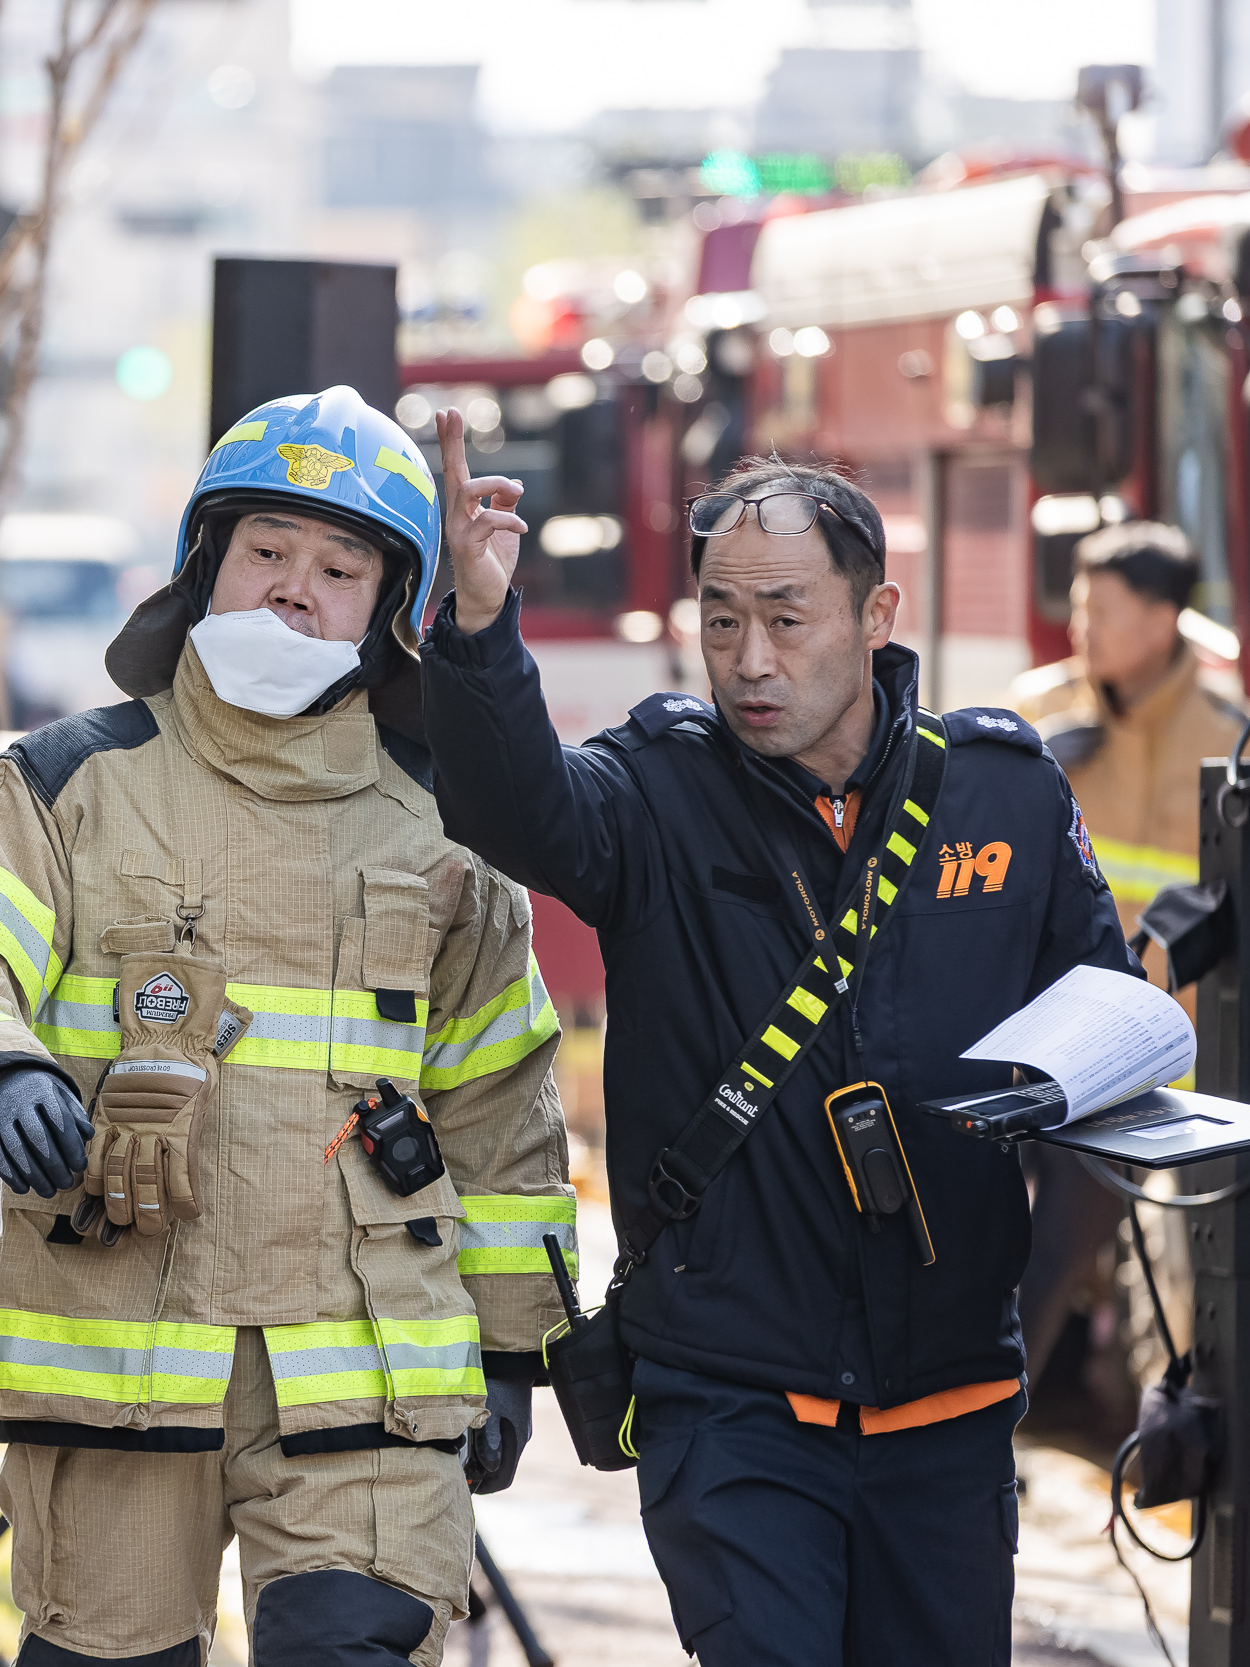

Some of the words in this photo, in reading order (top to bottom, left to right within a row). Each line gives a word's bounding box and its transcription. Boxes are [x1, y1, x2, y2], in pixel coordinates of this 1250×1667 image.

[938, 841, 973, 861] 소방
[936, 841, 1012, 899] 119
[791, 871, 819, 926] MOTOROLA
[861, 870, 874, 930] MOTOROLA
[137, 996, 187, 1011] FIREBOLT
[146, 1010, 176, 1018] PREMIUM
[216, 1023, 236, 1048] SEES
[718, 1083, 759, 1117] Courant
